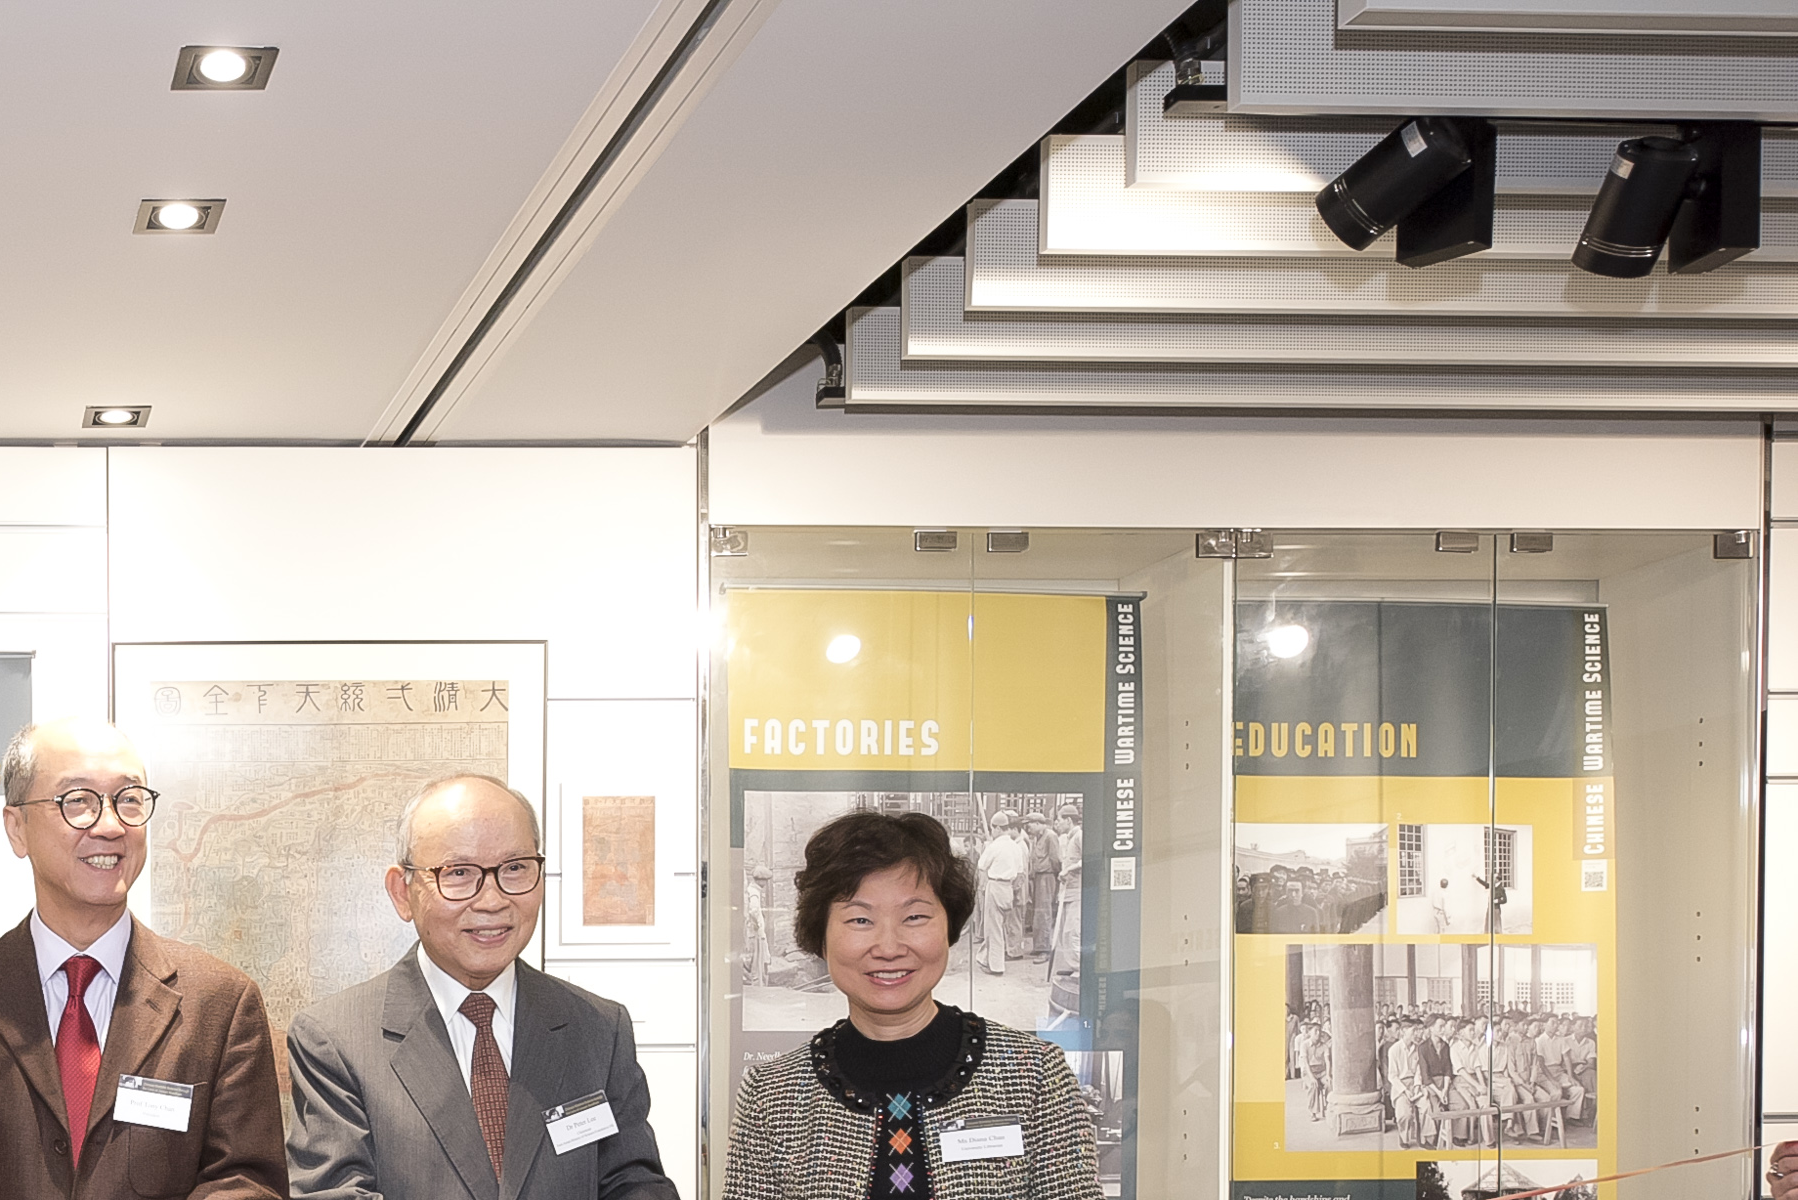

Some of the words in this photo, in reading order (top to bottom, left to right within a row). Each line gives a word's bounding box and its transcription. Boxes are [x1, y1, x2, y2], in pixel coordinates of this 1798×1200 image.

[1116, 603, 1134, 674] SCIENCE
[1582, 612, 1601, 682] SCIENCE
[743, 718, 940, 756] FACTORIES
[1115, 681, 1135, 765] WARTIME
[1232, 721, 1418, 758] EDUCATION
[1583, 689, 1603, 771] WARTIME
[1113, 778, 1135, 851] CHINESE
[1583, 783, 1604, 855] CHINESE
